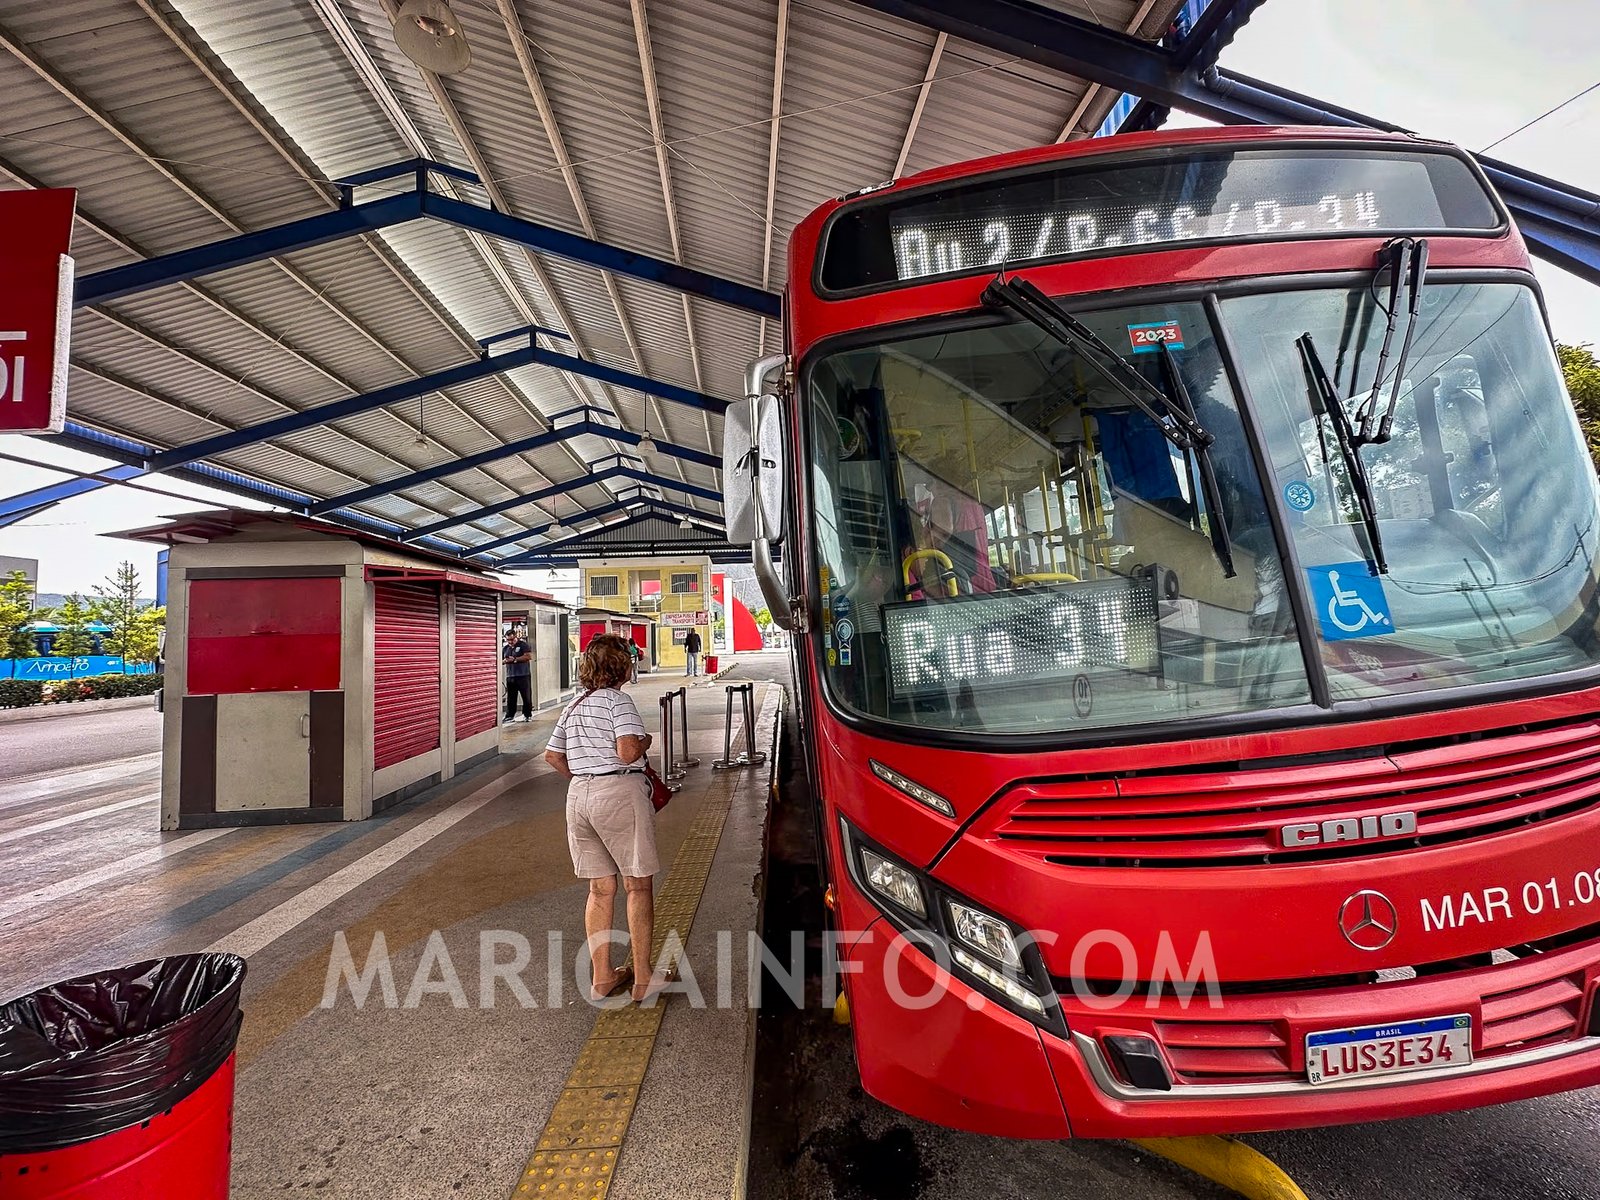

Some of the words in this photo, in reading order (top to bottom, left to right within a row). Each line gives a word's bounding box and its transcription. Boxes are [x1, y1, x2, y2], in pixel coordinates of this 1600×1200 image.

[1135, 328, 1177, 343] 2023
[902, 620, 1014, 683] Rua
[1052, 599, 1129, 665] 34
[26, 660, 90, 674] Amparo
[1282, 811, 1417, 848] CAIO
[1420, 887, 1513, 932] MAR
[1375, 1029, 1402, 1038] BRASIL
[1321, 1034, 1453, 1077] LUS3E34
[1311, 1072, 1322, 1083] BR
